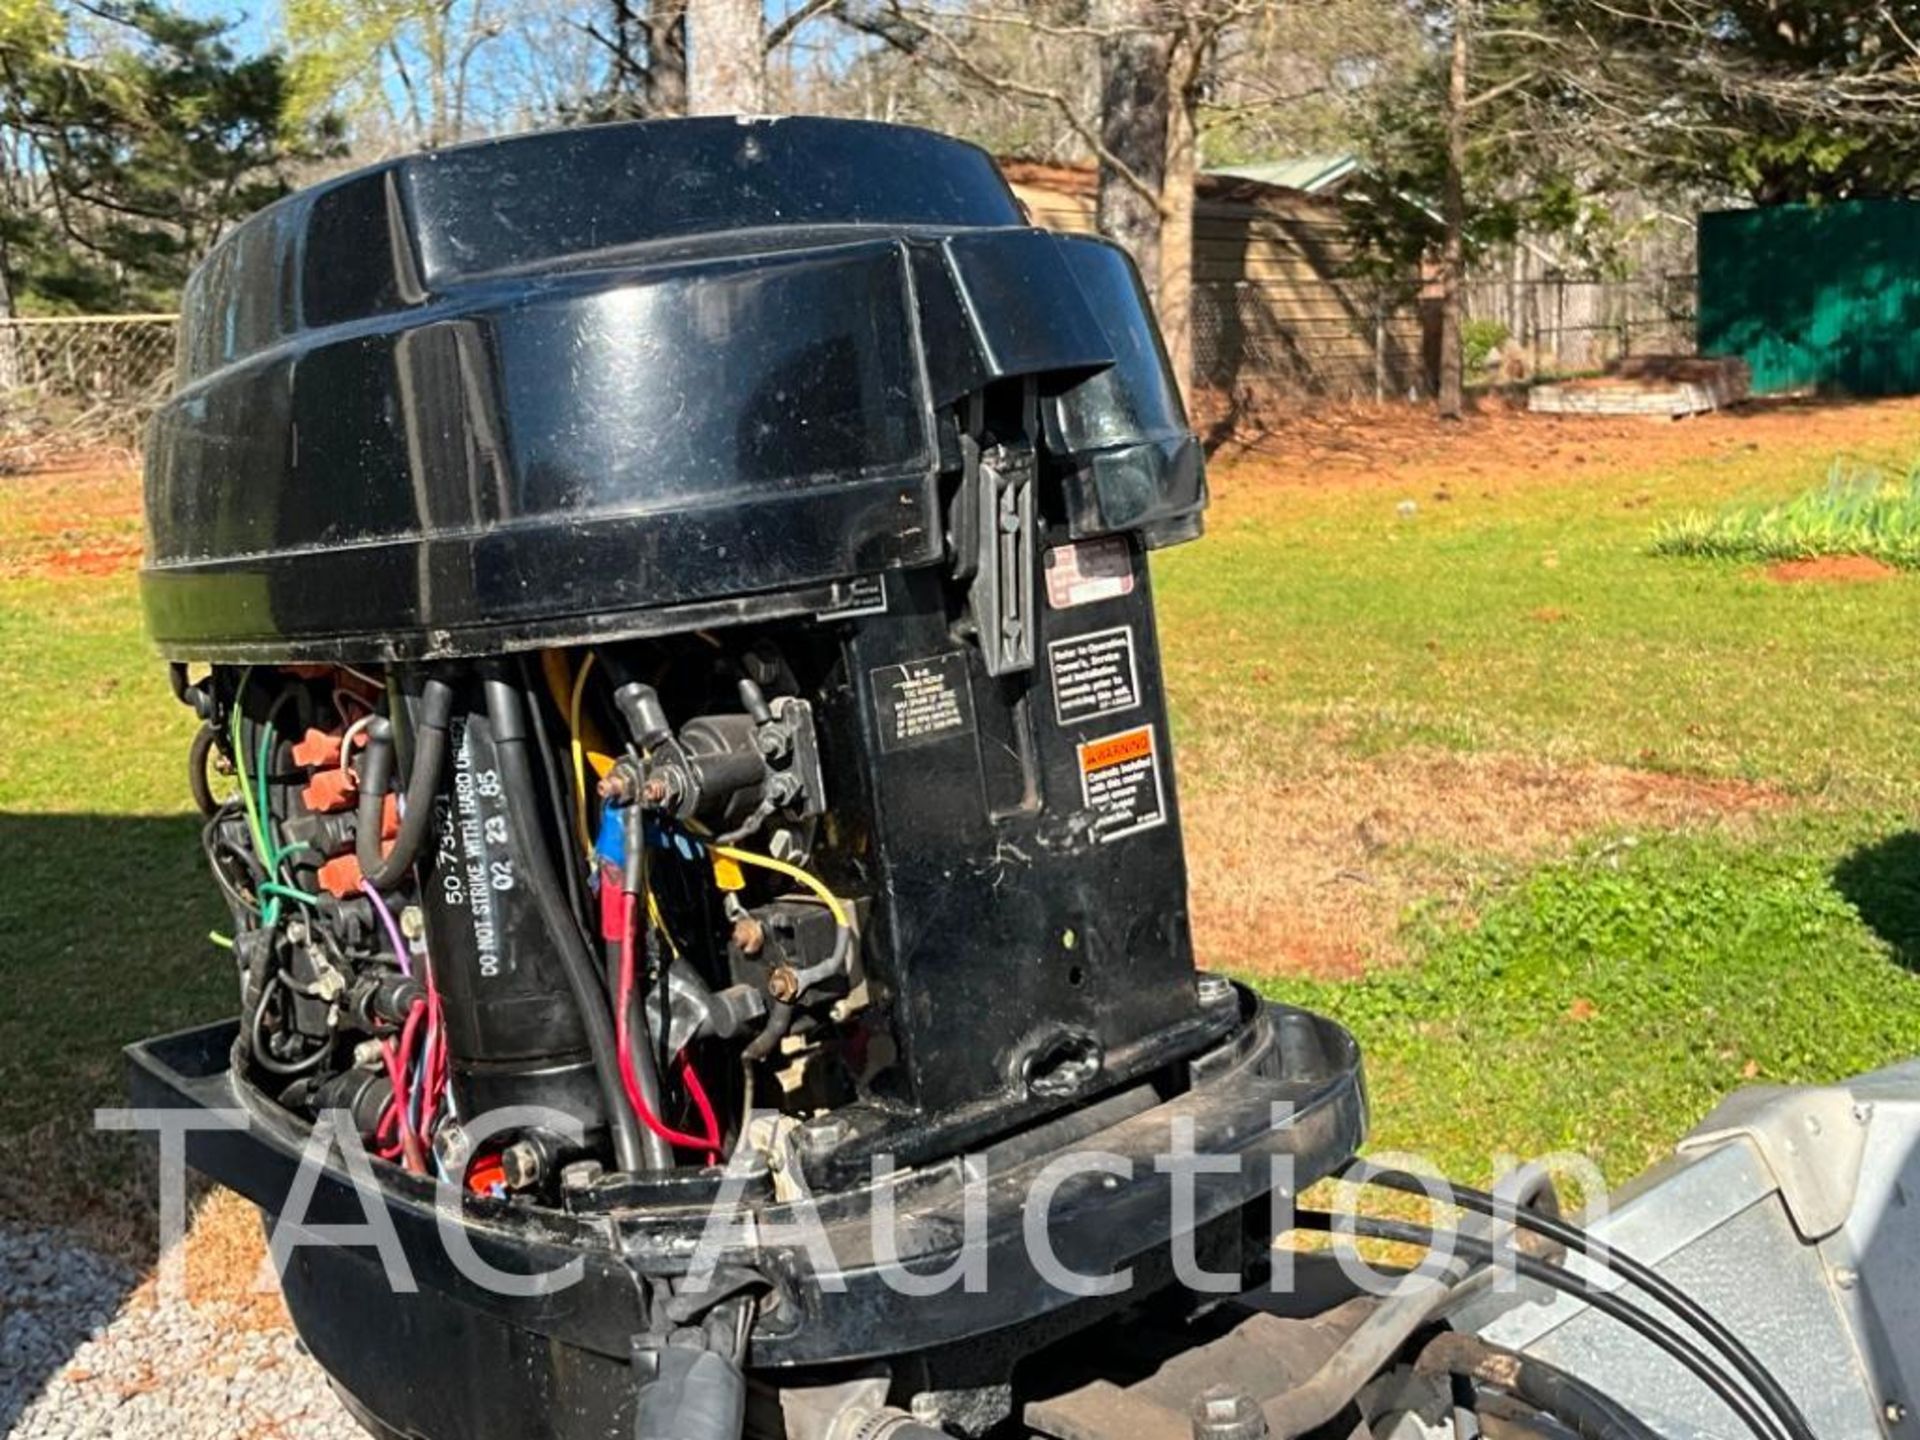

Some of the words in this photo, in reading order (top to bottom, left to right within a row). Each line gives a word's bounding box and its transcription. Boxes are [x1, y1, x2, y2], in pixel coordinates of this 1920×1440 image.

[455, 772, 477, 815] HARD
[475, 768, 501, 797] 85
[460, 819, 482, 858] WITH
[484, 815, 507, 845] 23
[466, 862, 492, 916] STRIKE
[490, 858, 514, 891] 02
[473, 918, 495, 951] NOT
[479, 953, 500, 978] DO
